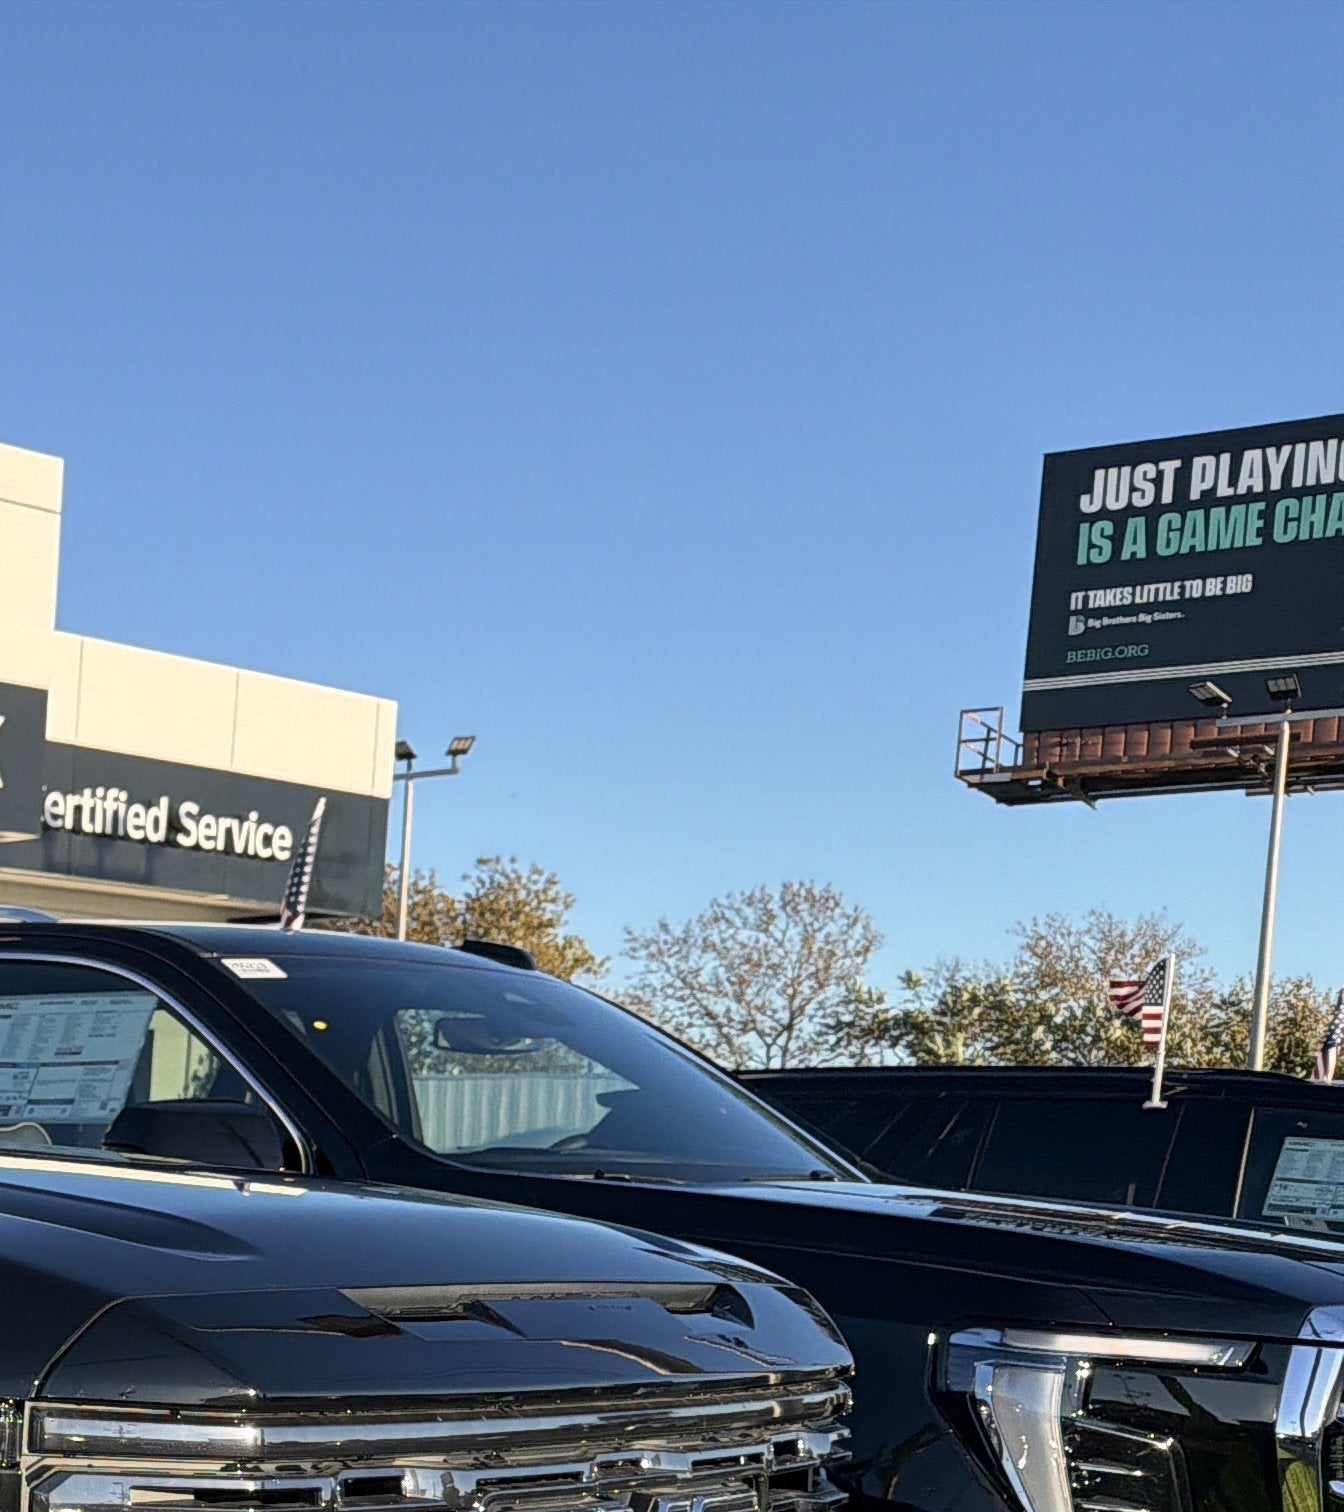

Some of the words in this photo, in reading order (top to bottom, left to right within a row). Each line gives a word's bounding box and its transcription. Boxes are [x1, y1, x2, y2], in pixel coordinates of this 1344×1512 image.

[1079, 460, 1182, 514] JUST
[1076, 519, 1114, 566] IS
[1120, 516, 1147, 560] A
[1155, 502, 1267, 557] GAME
[1069, 591, 1087, 610] IT
[1087, 586, 1133, 609] TAKES
[1134, 581, 1181, 604] LITTLE
[1183, 578, 1204, 599] TO
[1205, 576, 1225, 597] BE
[1225, 573, 1254, 595] BIG
[1087, 618, 1102, 629] Big
[1102, 615, 1137, 626] Brothers
[1138, 612, 1153, 624] Big
[1065, 644, 1150, 664] BEBIG.ORG
[41, 785, 169, 843] ertified
[176, 801, 294, 861] Service
